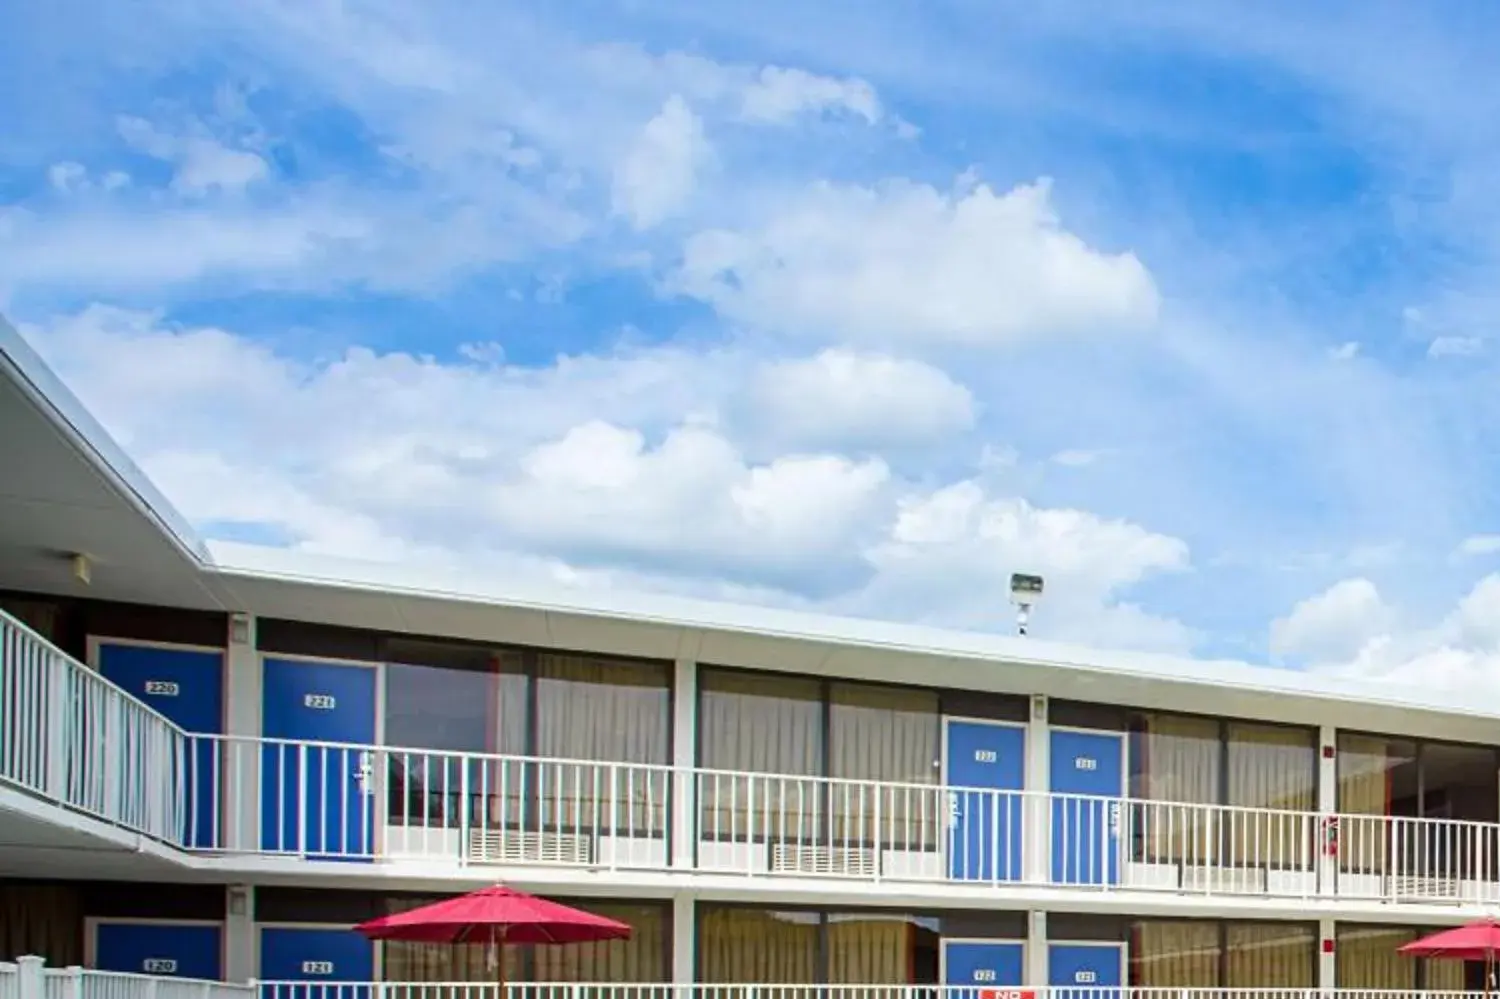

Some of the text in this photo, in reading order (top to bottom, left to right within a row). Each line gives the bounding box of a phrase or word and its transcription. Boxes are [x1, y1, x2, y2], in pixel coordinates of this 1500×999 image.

[150, 682, 175, 694] 220
[307, 962, 330, 973] 121
[995, 991, 1020, 999] NO
